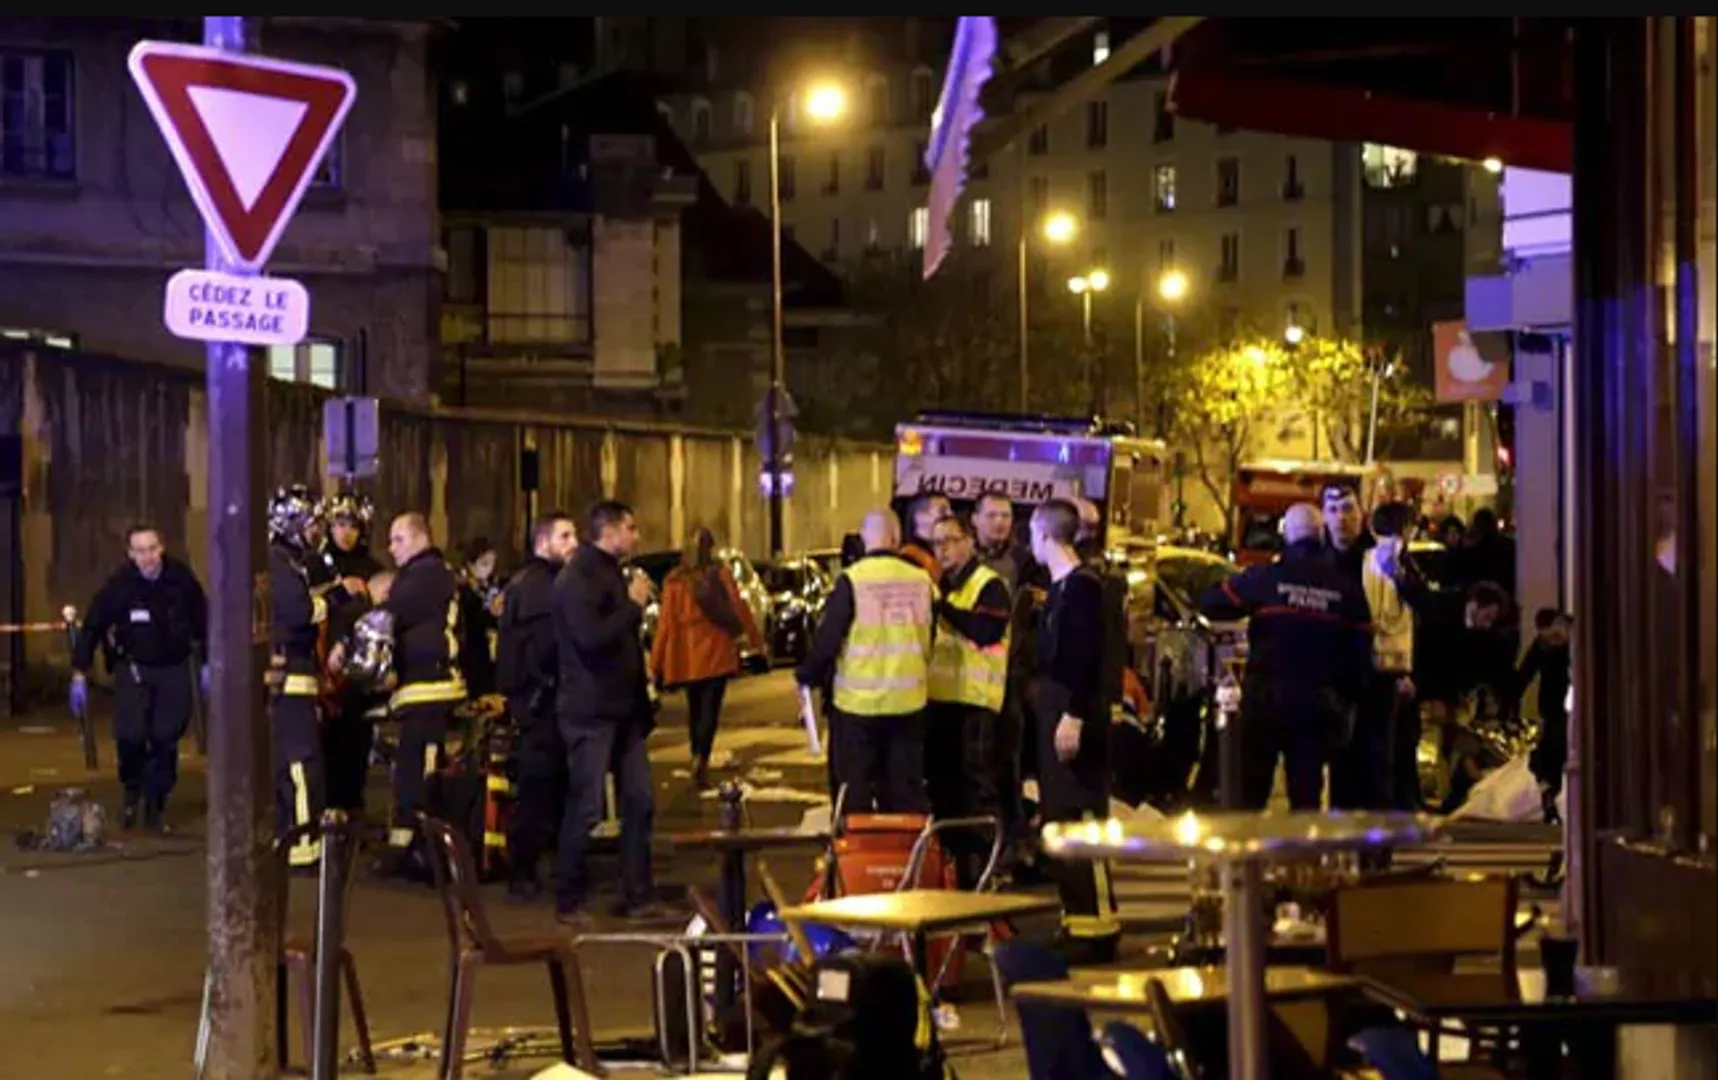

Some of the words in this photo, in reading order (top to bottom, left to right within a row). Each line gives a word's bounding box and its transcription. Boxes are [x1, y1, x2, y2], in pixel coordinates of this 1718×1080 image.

[189, 281, 251, 306] CÉDEZ
[265, 291, 287, 310] LE
[189, 307, 284, 333] PASSAGE
